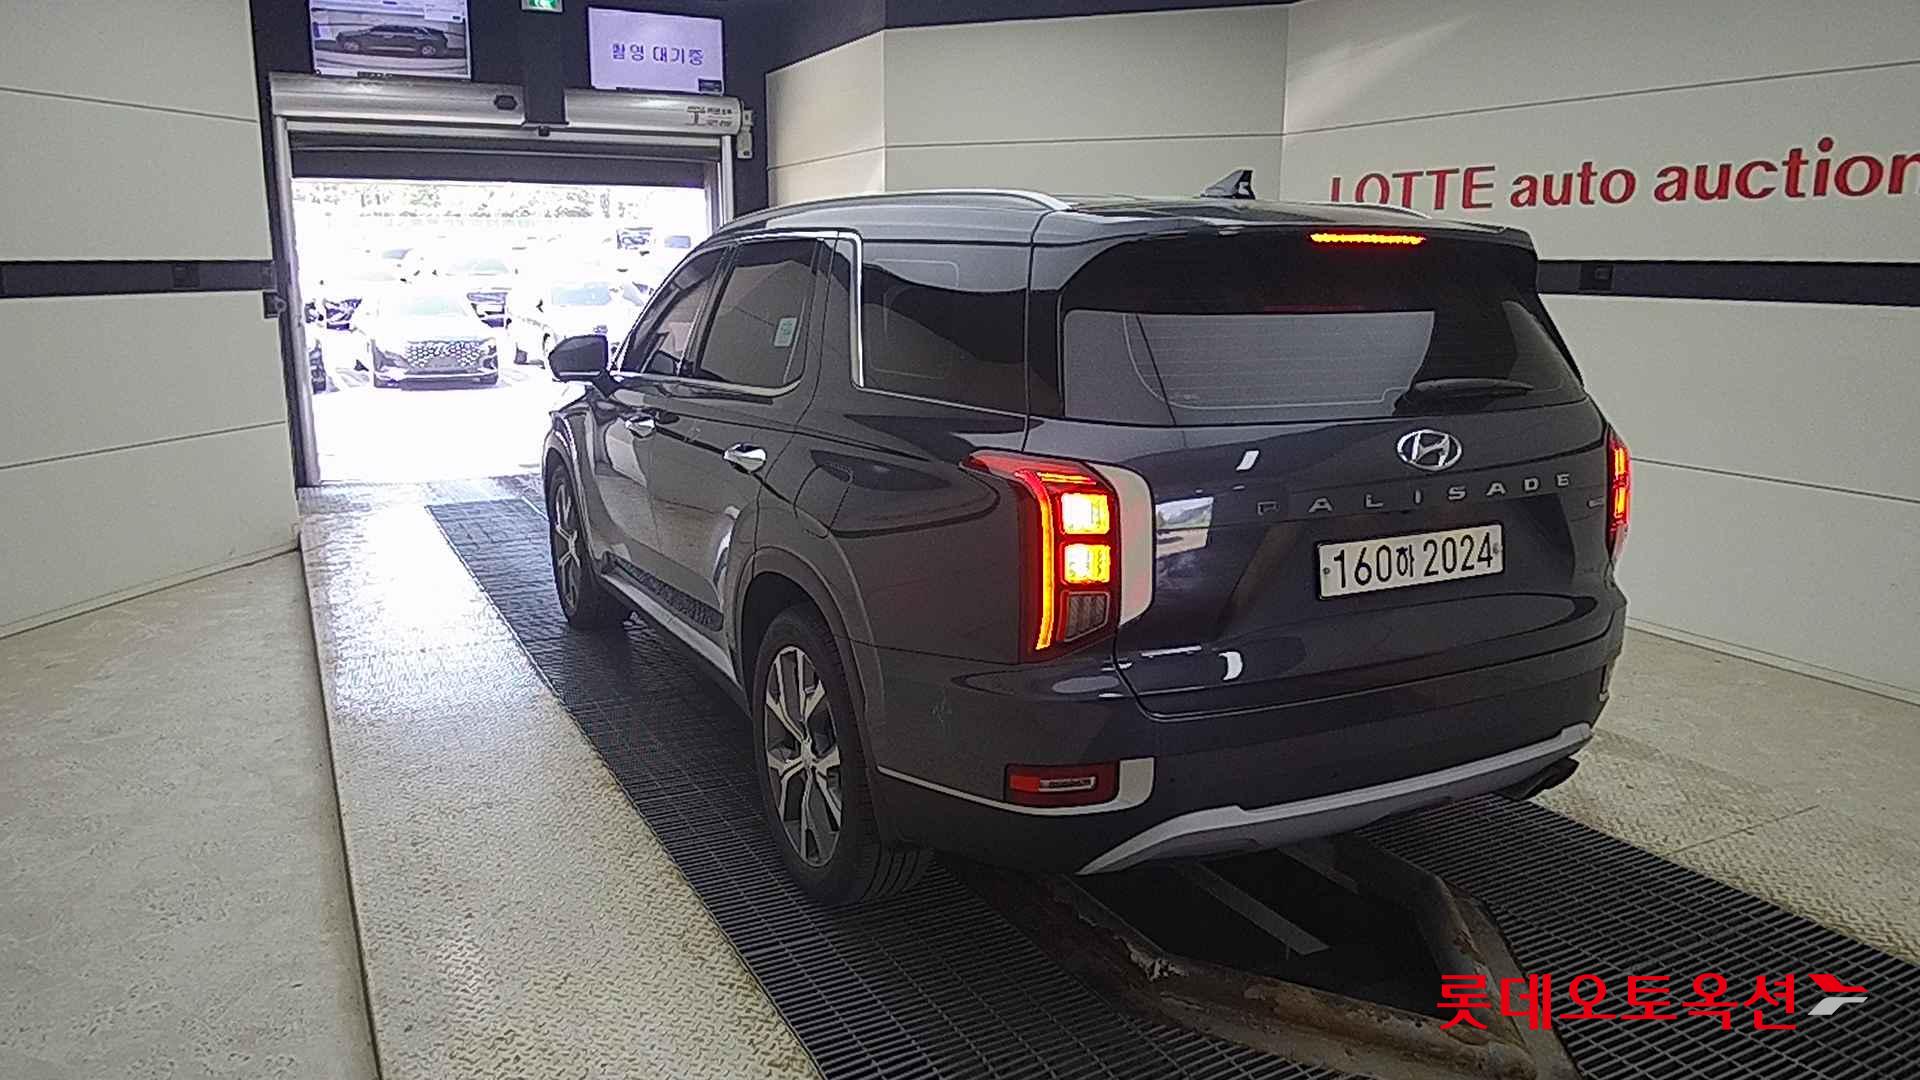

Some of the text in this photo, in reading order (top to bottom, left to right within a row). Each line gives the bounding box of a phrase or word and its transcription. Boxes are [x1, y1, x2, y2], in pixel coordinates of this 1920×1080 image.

[653, 46, 704, 66] 대기중
[1510, 161, 1637, 207] auto
[1257, 473, 1570, 516] PALISADE
